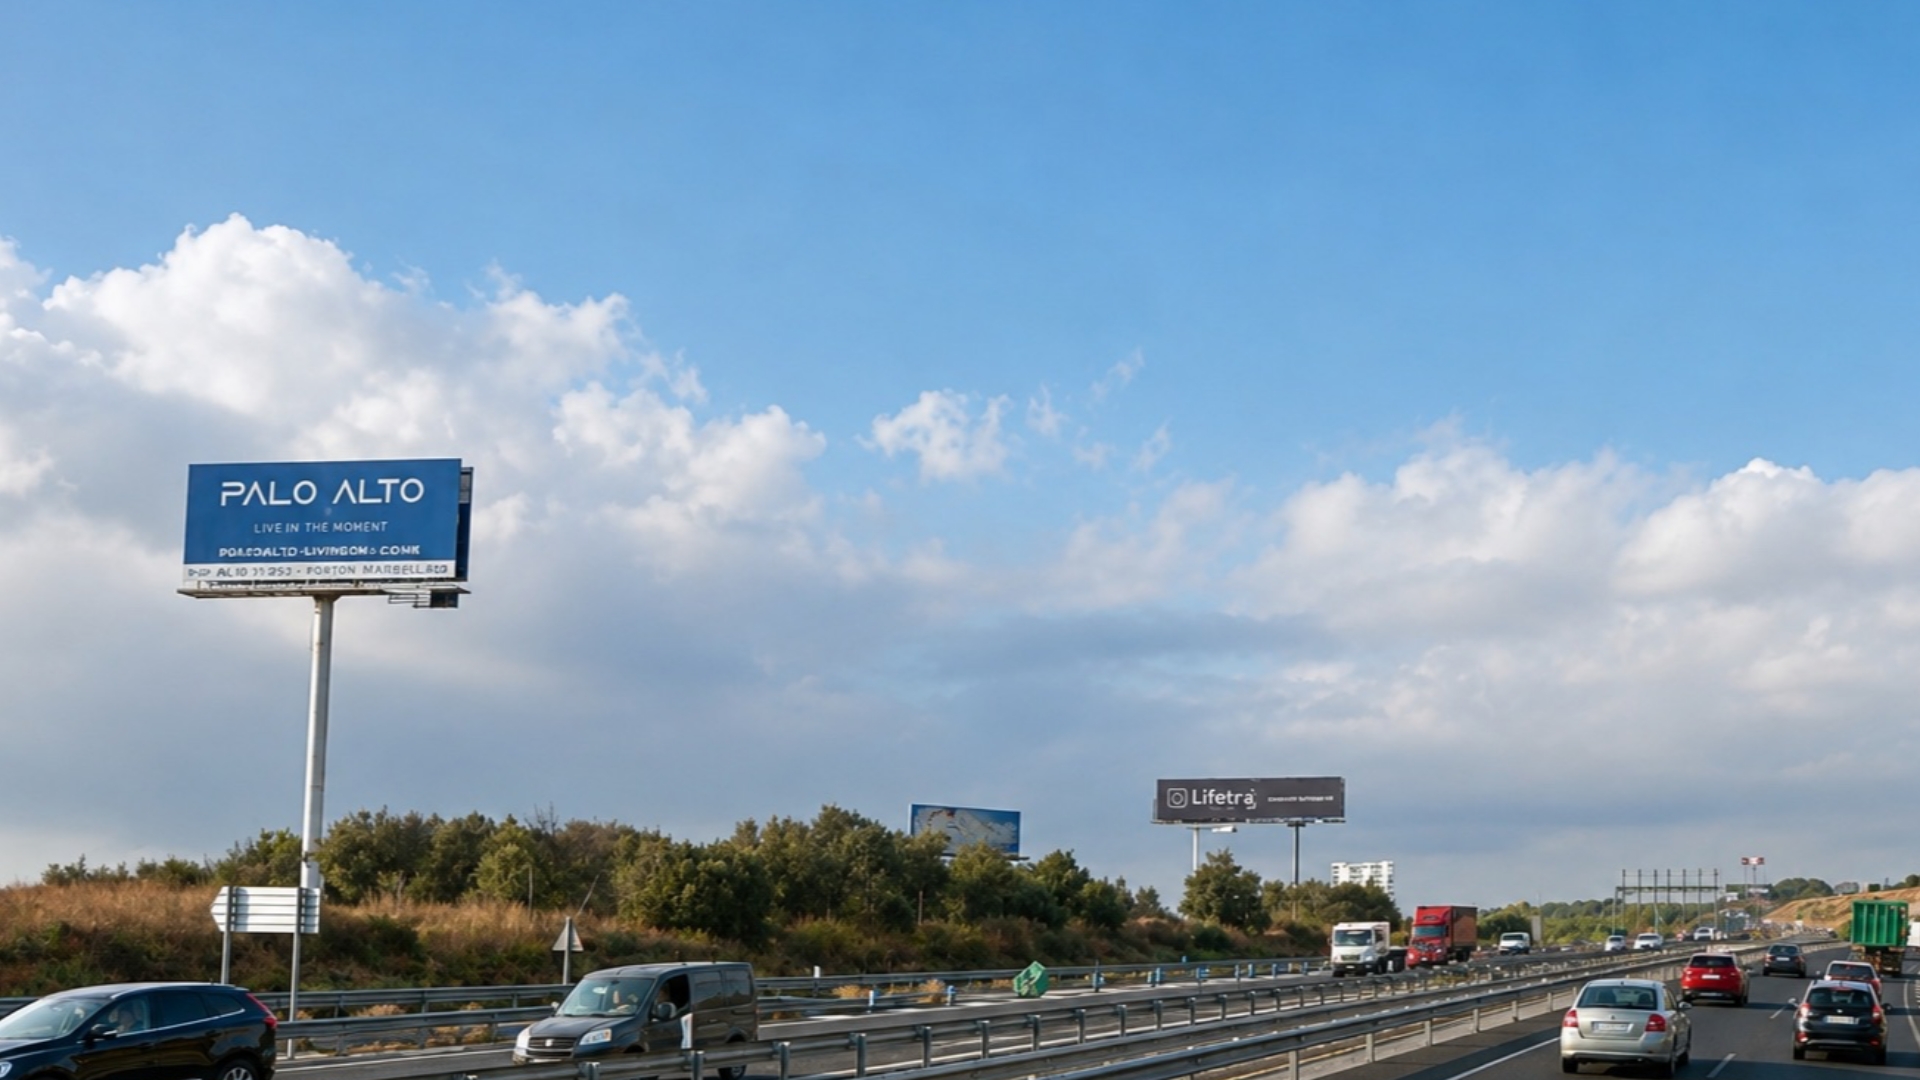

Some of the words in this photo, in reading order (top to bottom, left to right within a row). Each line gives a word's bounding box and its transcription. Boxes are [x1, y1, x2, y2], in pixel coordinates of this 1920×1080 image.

[220, 480, 318, 507] PALO
[331, 478, 425, 505] ALTO
[254, 522, 283, 534] LIVE
[285, 522, 300, 533] IN
[304, 522, 329, 533] THE
